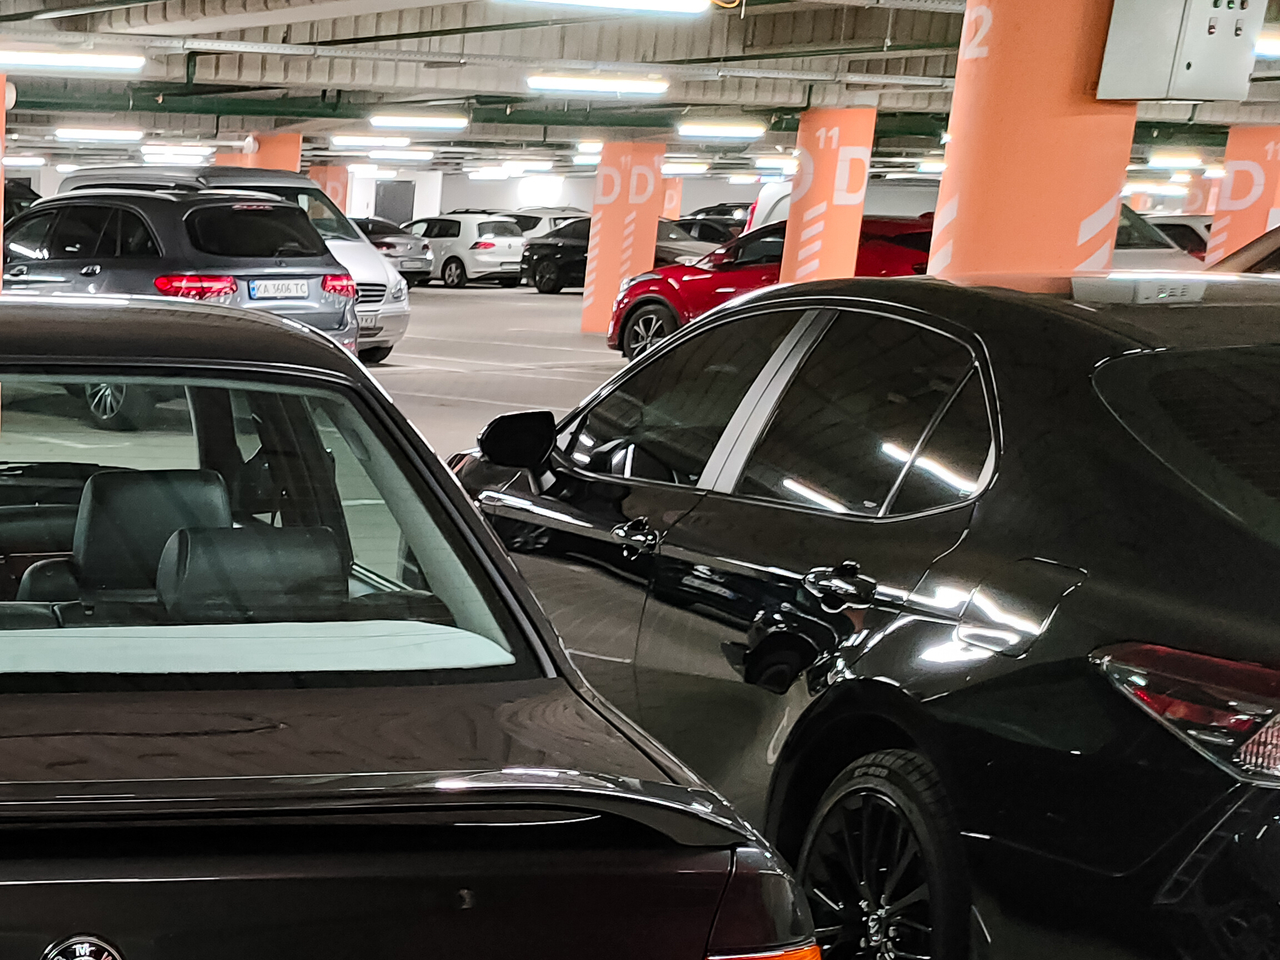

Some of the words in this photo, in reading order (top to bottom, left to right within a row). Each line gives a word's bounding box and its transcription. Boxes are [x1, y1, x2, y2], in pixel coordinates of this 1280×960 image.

[816, 127, 839, 149] 11
[621, 155, 632, 170] 11
[833, 146, 870, 205] D
[595, 166, 621, 205] D
[629, 165, 655, 204] D
[1220, 160, 1266, 210] D
[256, 283, 270, 294] KA
[293, 283, 307, 294] TC
